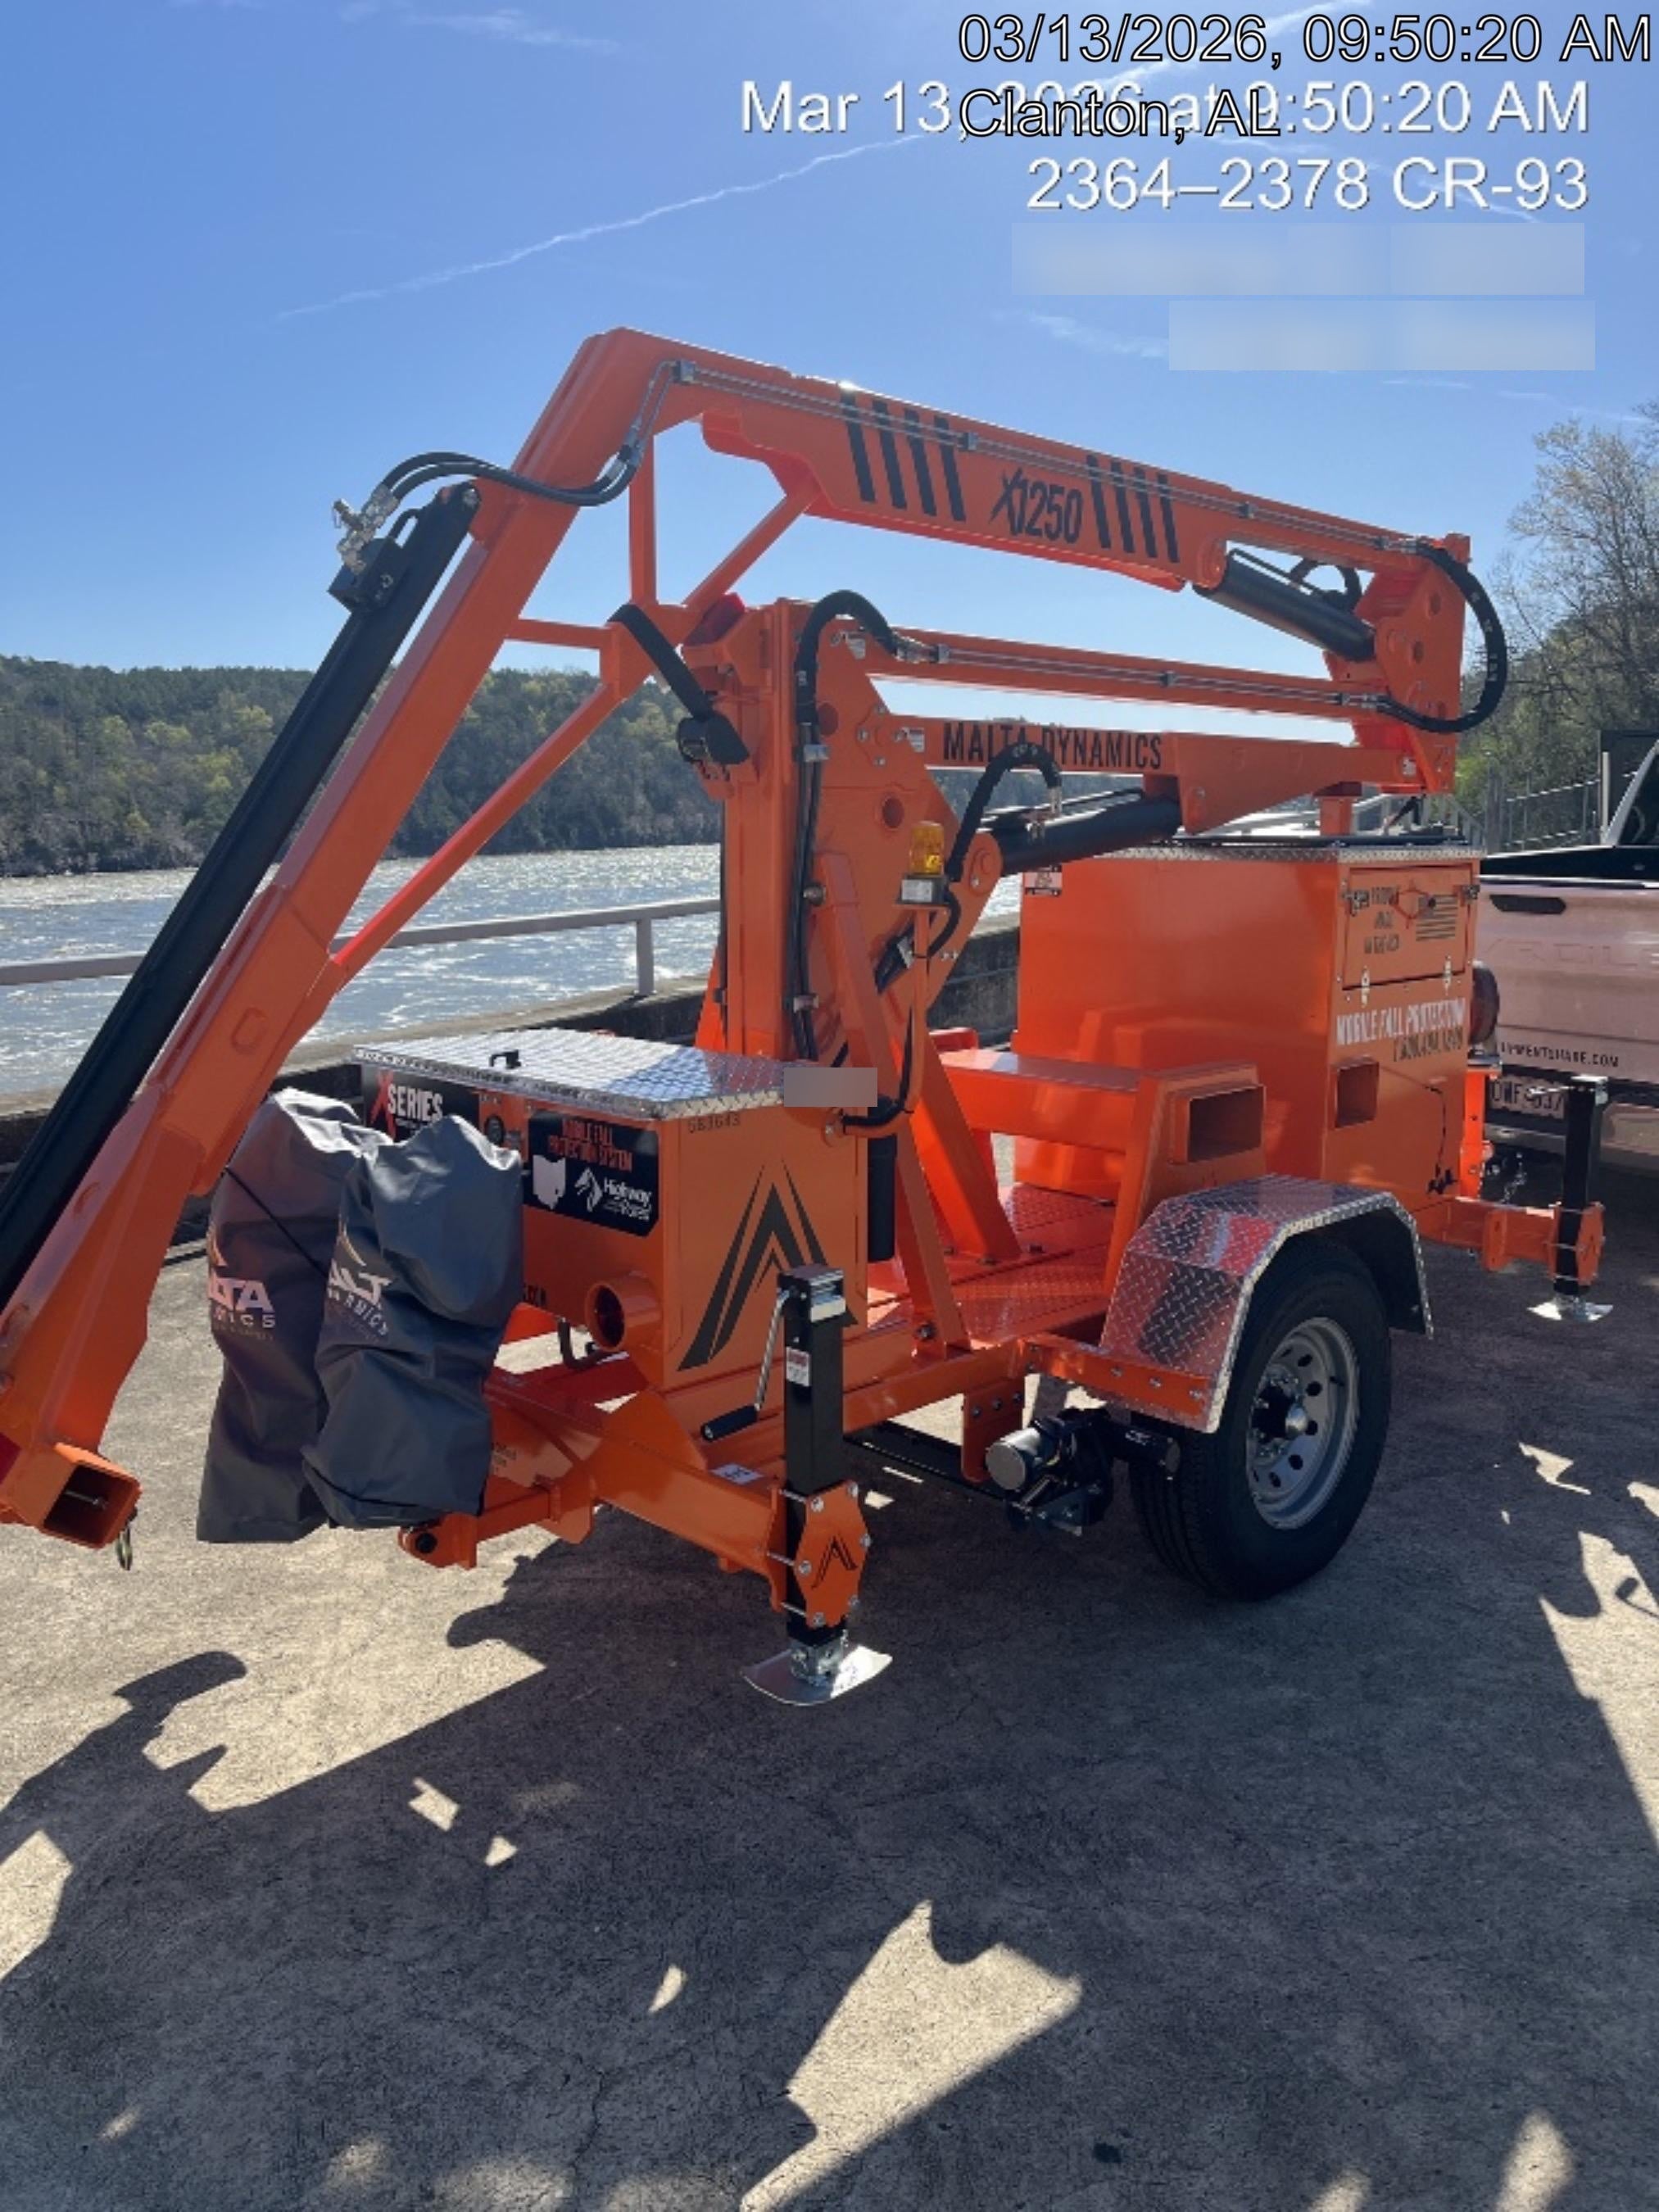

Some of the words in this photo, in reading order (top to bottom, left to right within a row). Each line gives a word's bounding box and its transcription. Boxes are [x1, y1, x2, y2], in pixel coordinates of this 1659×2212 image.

[1040, 728, 1163, 769] DYNAMICS
[1378, 1006, 1404, 1040] FALL
[388, 1083, 443, 1123] SERIES
